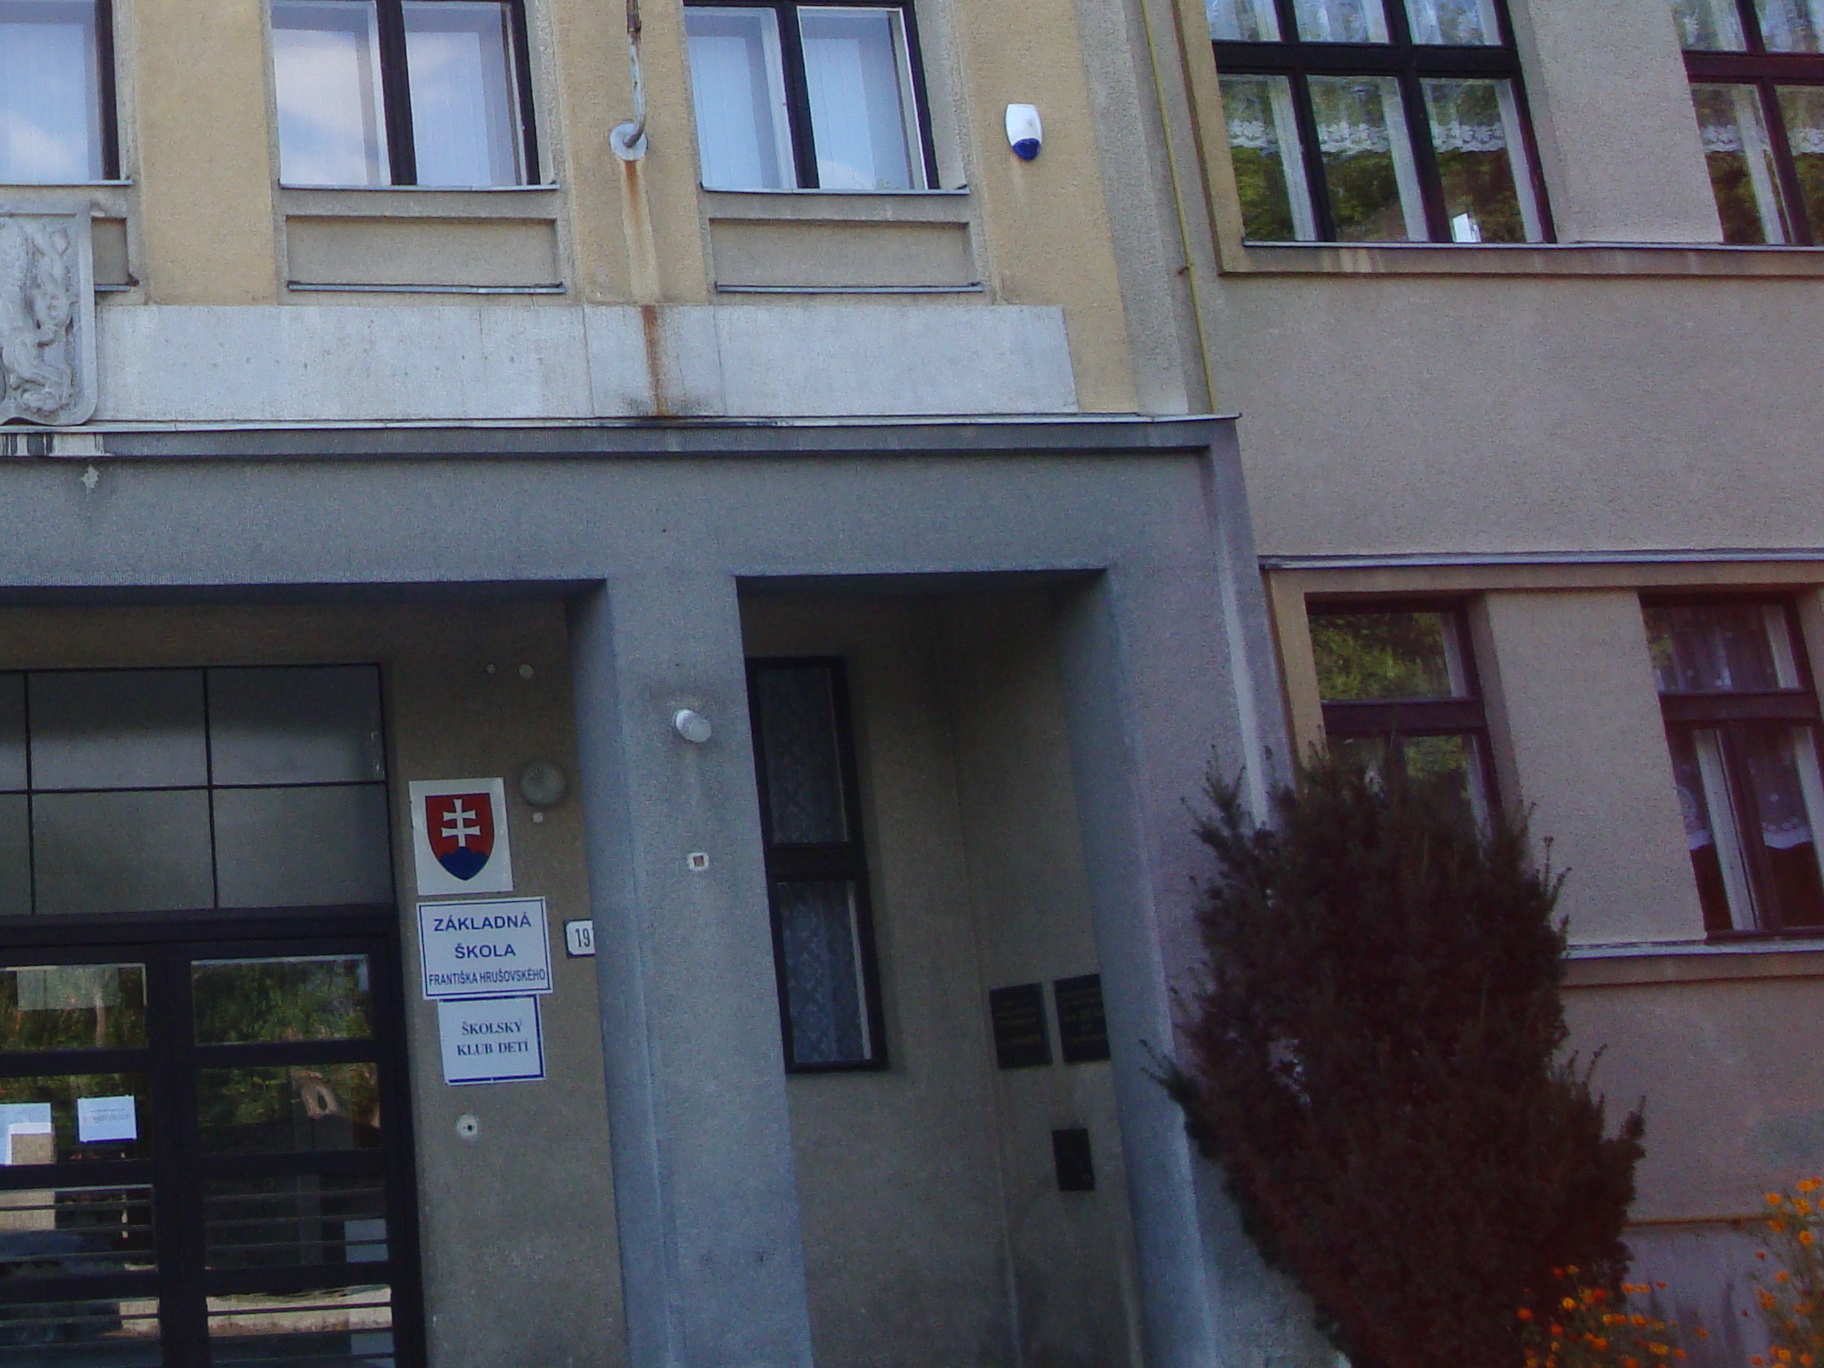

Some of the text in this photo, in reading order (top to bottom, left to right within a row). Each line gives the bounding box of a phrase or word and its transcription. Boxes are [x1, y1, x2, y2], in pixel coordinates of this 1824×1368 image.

[433, 911, 532, 932] ZÁKLADNÁ
[575, 927, 591, 948] 19
[454, 942, 516, 959] ŠKOLA
[428, 966, 546, 986] FRANTIŠKA HRUŠOVSKÉHO
[461, 1019, 522, 1036] ŠKOLSKÝ
[457, 1038, 529, 1056] KLUB DETÍ
